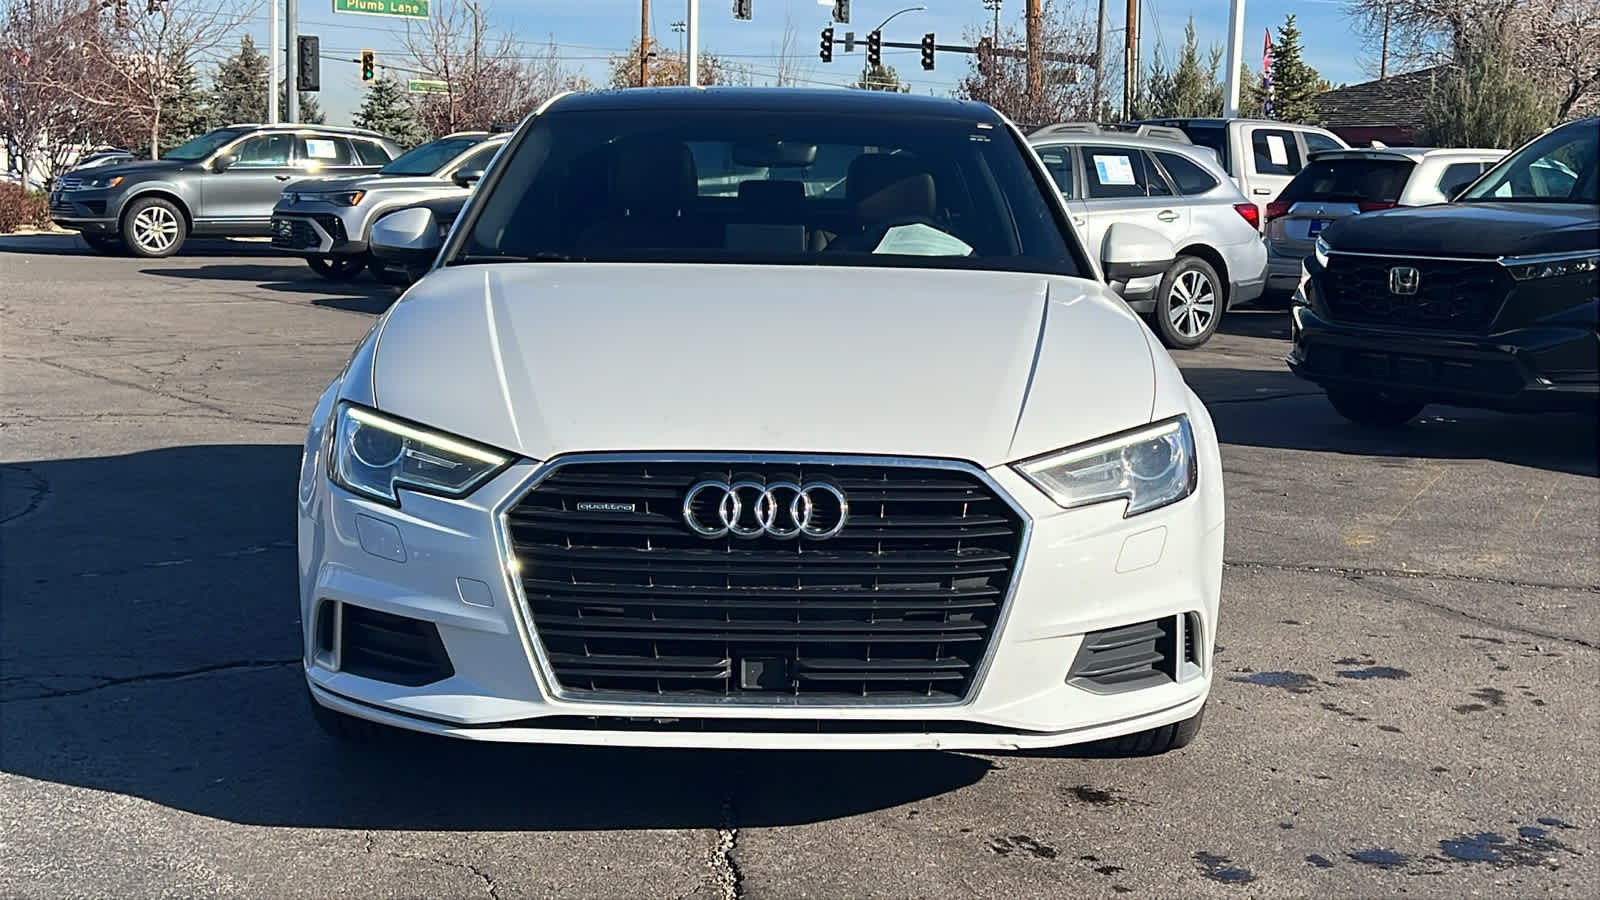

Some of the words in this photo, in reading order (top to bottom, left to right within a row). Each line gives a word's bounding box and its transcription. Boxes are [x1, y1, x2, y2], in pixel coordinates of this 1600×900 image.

[346, 0, 385, 10] Plumb
[390, 2, 419, 13] Lane
[579, 503, 632, 511] quattro
